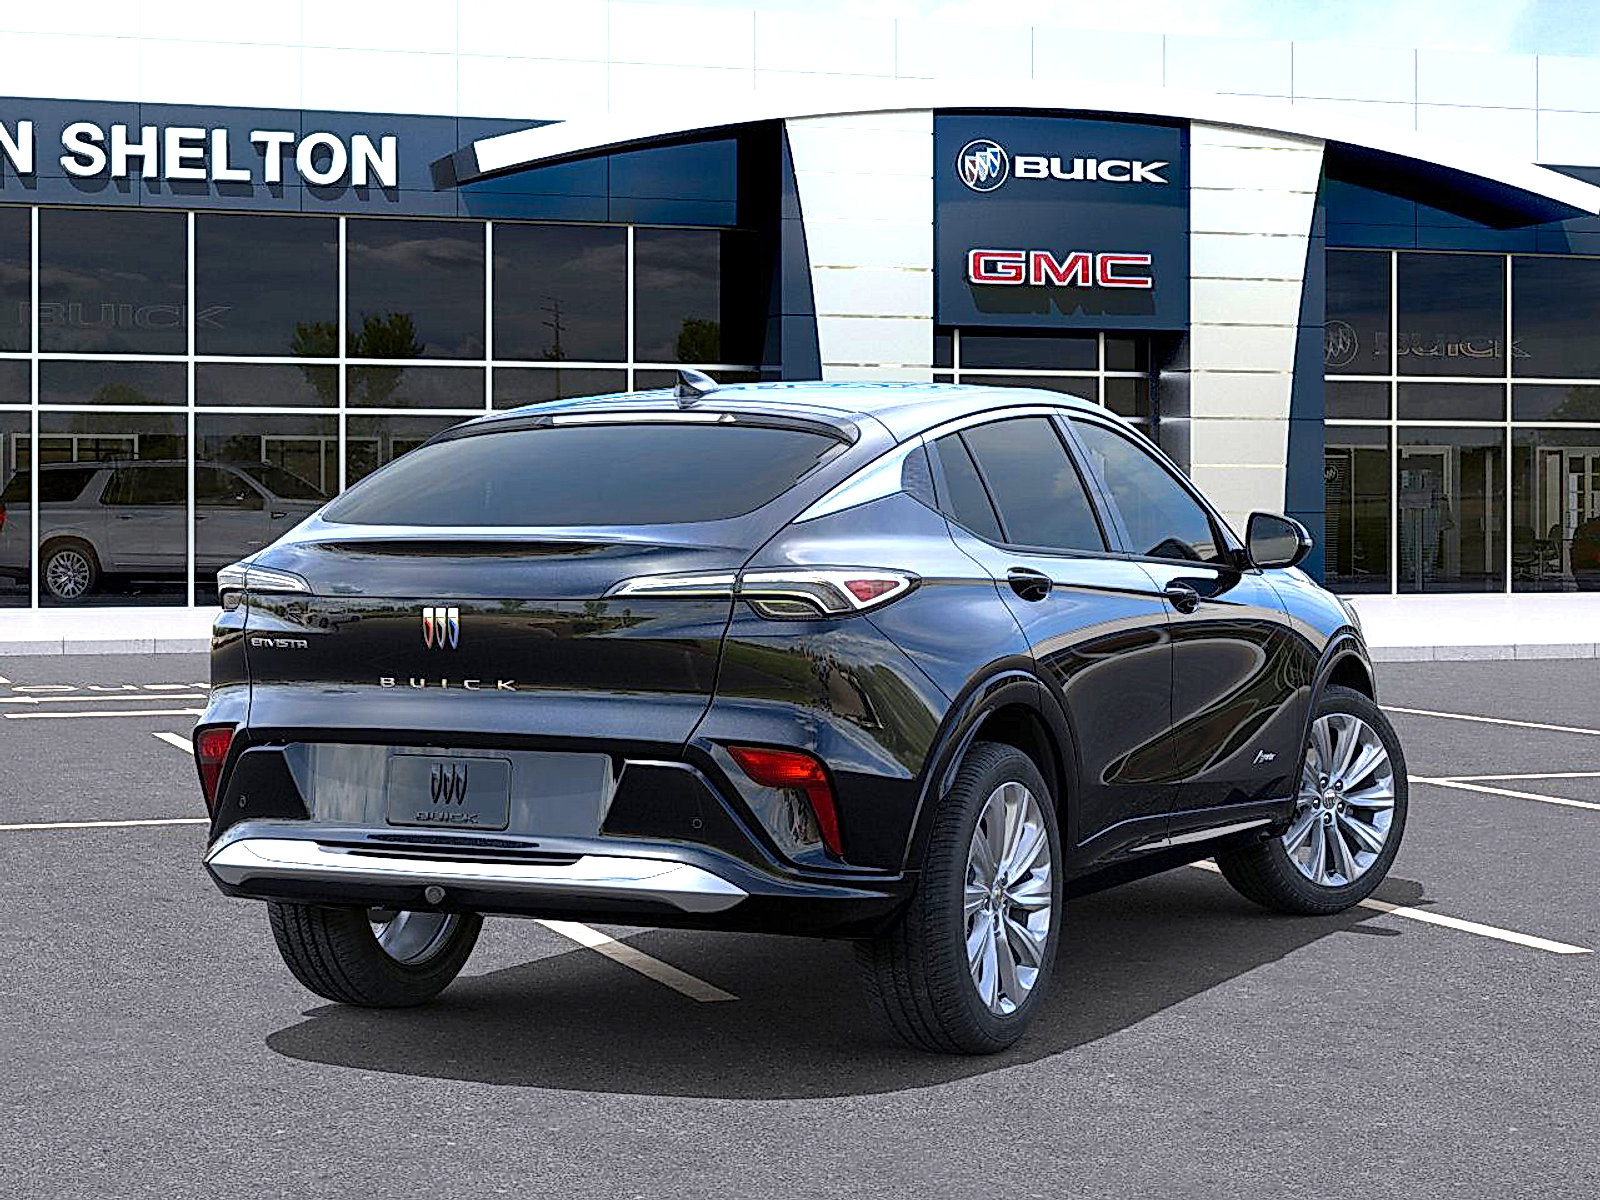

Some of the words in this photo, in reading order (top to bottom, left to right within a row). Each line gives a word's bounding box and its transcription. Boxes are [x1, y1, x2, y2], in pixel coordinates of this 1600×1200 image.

[59, 121, 398, 187] SHELTON
[1014, 155, 1169, 184] BUICK
[968, 249, 1153, 289] GMC
[251, 637, 308, 649] ENVISTA
[380, 676, 517, 691] BUICK
[416, 811, 481, 824] BUICK
